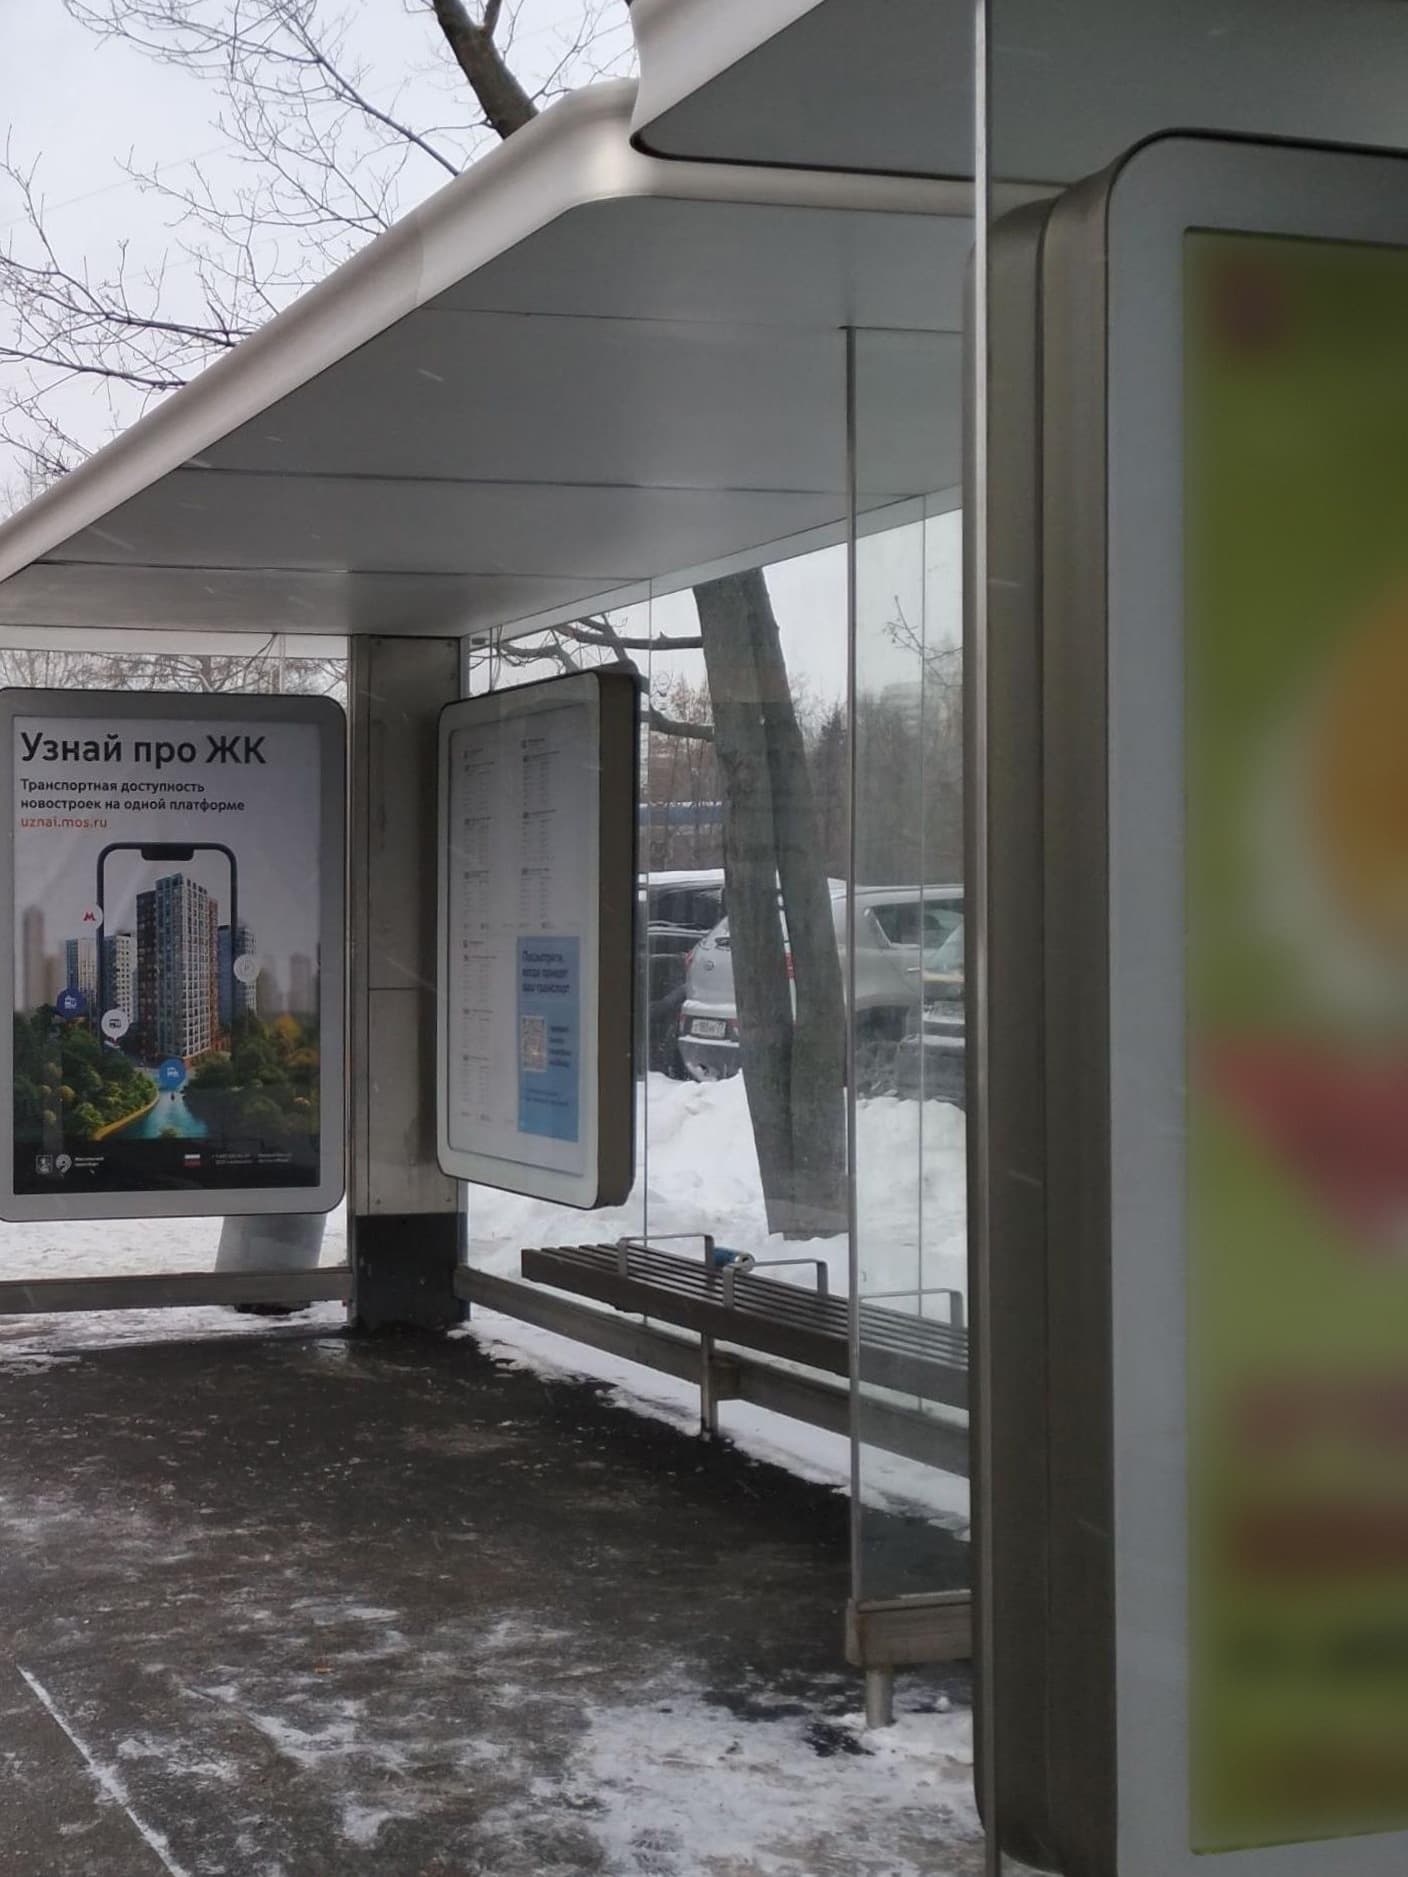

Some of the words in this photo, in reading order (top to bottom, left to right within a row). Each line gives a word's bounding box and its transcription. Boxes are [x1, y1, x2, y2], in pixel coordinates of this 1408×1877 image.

[20, 732, 122, 763] Узнай
[134, 741, 197, 769] про
[205, 735, 266, 764] ЖК
[20, 778, 118, 794] Транспортная
[121, 781, 205, 794] доступность
[20, 799, 102, 812] новостроек
[105, 800, 120, 810] на
[124, 797, 166, 812] одной
[170, 799, 245, 812] платформе
[20, 816, 108, 829] uznai.mos.ru
